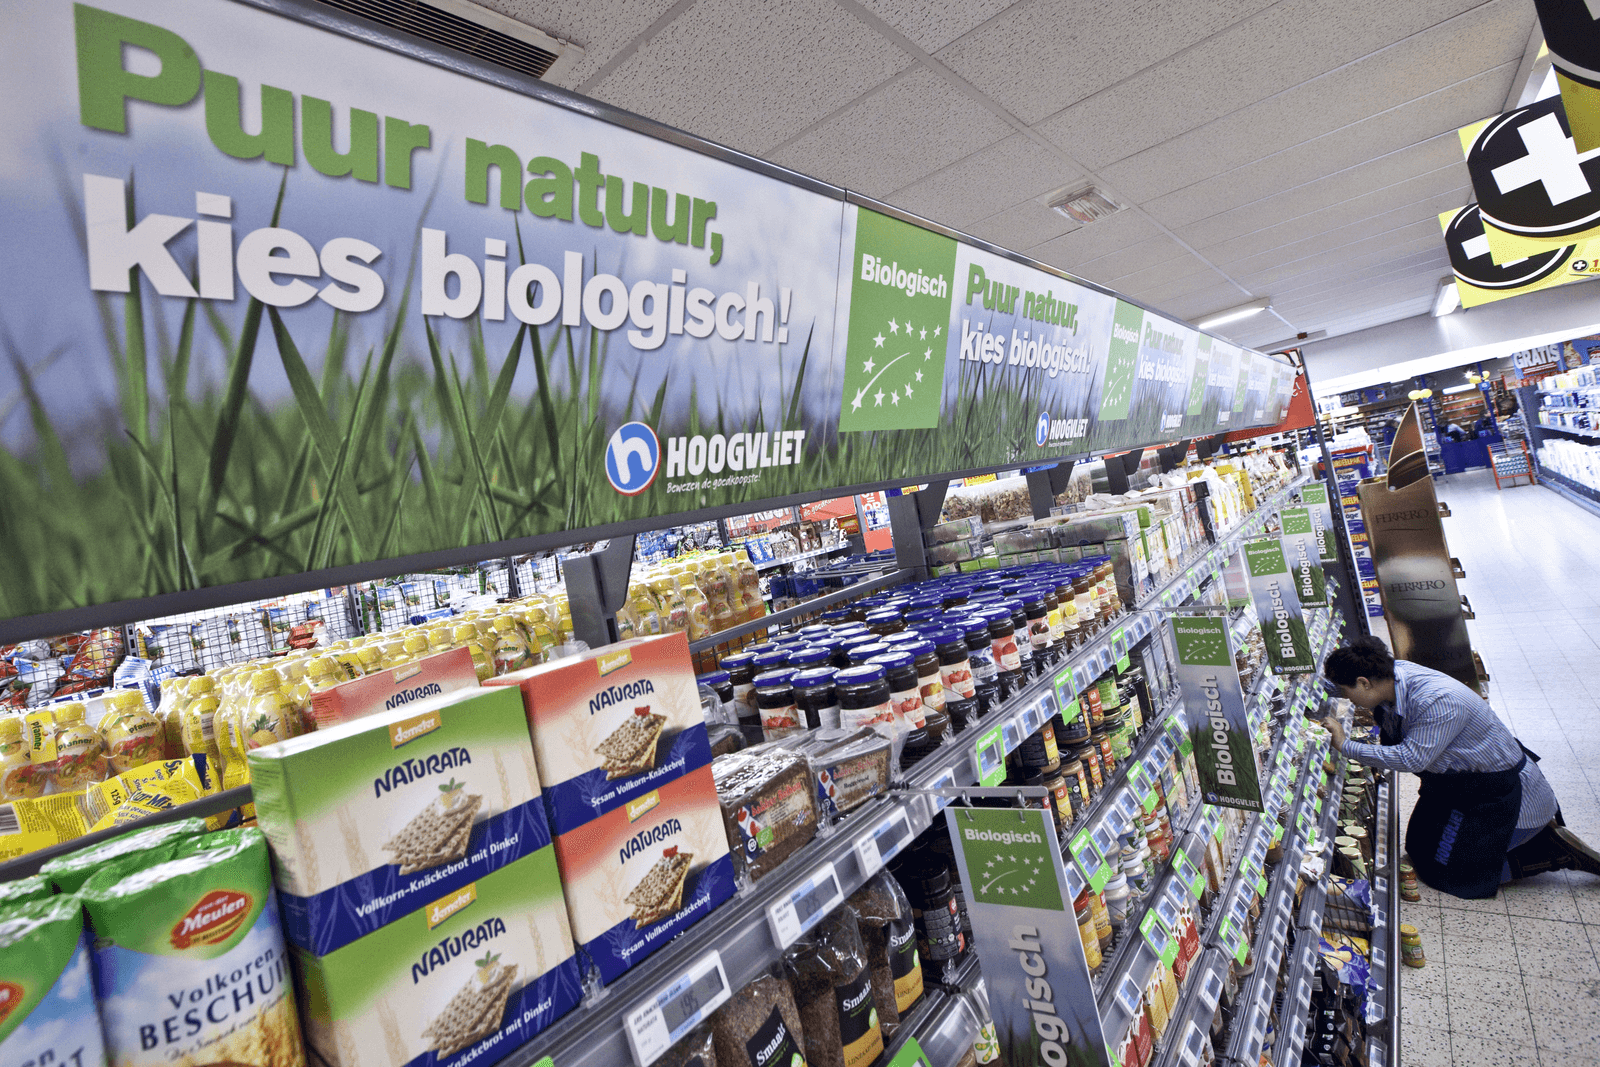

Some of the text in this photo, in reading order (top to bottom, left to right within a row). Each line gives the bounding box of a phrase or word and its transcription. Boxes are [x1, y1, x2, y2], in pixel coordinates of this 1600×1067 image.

[73, 2, 723, 265] Puur natuur,
[83, 173, 792, 350] kies biologisch!
[861, 253, 948, 298] Biologisch
[966, 262, 1079, 337] Puur natuur,
[959, 319, 1095, 378] kies biologisch!
[1513, 343, 1560, 369] GRATIS
[666, 470, 762, 494] Bewezen de goedkoopste!
[1313, 508, 1327, 554] Biologisch
[1375, 508, 1429, 524] FERRERO
[1295, 538, 1314, 597] Biologisch
[1390, 579, 1446, 593] FERRERO
[1177, 627, 1222, 636] Biologisch
[1265, 580, 1296, 659] Biologisch
[385, 683, 442, 711] NATURATA
[588, 679, 655, 716] NATURATA
[394, 715, 437, 743] demeter
[1200, 675, 1237, 786] Biologisch
[374, 747, 473, 799] NATURATA
[590, 756, 686, 808] Sesam Vollkorn-Knäckebrot
[1220, 795, 1260, 808] HOOGVLIET
[619, 818, 682, 865] NATURATA
[964, 828, 1042, 846] Biologisch
[355, 832, 520, 919] Vollkorn-Knäckebrot mit Dinkel
[180, 897, 246, 936] Meulen
[620, 892, 711, 961] Sesam Vollkorn-Knäckebrot
[411, 917, 507, 985] NATURATA
[139, 950, 286, 1051] BESCHUI
[168, 948, 274, 1010] Volkoren
[505, 1018, 522, 1036] mit
[523, 996, 552, 1023] Dinkel
